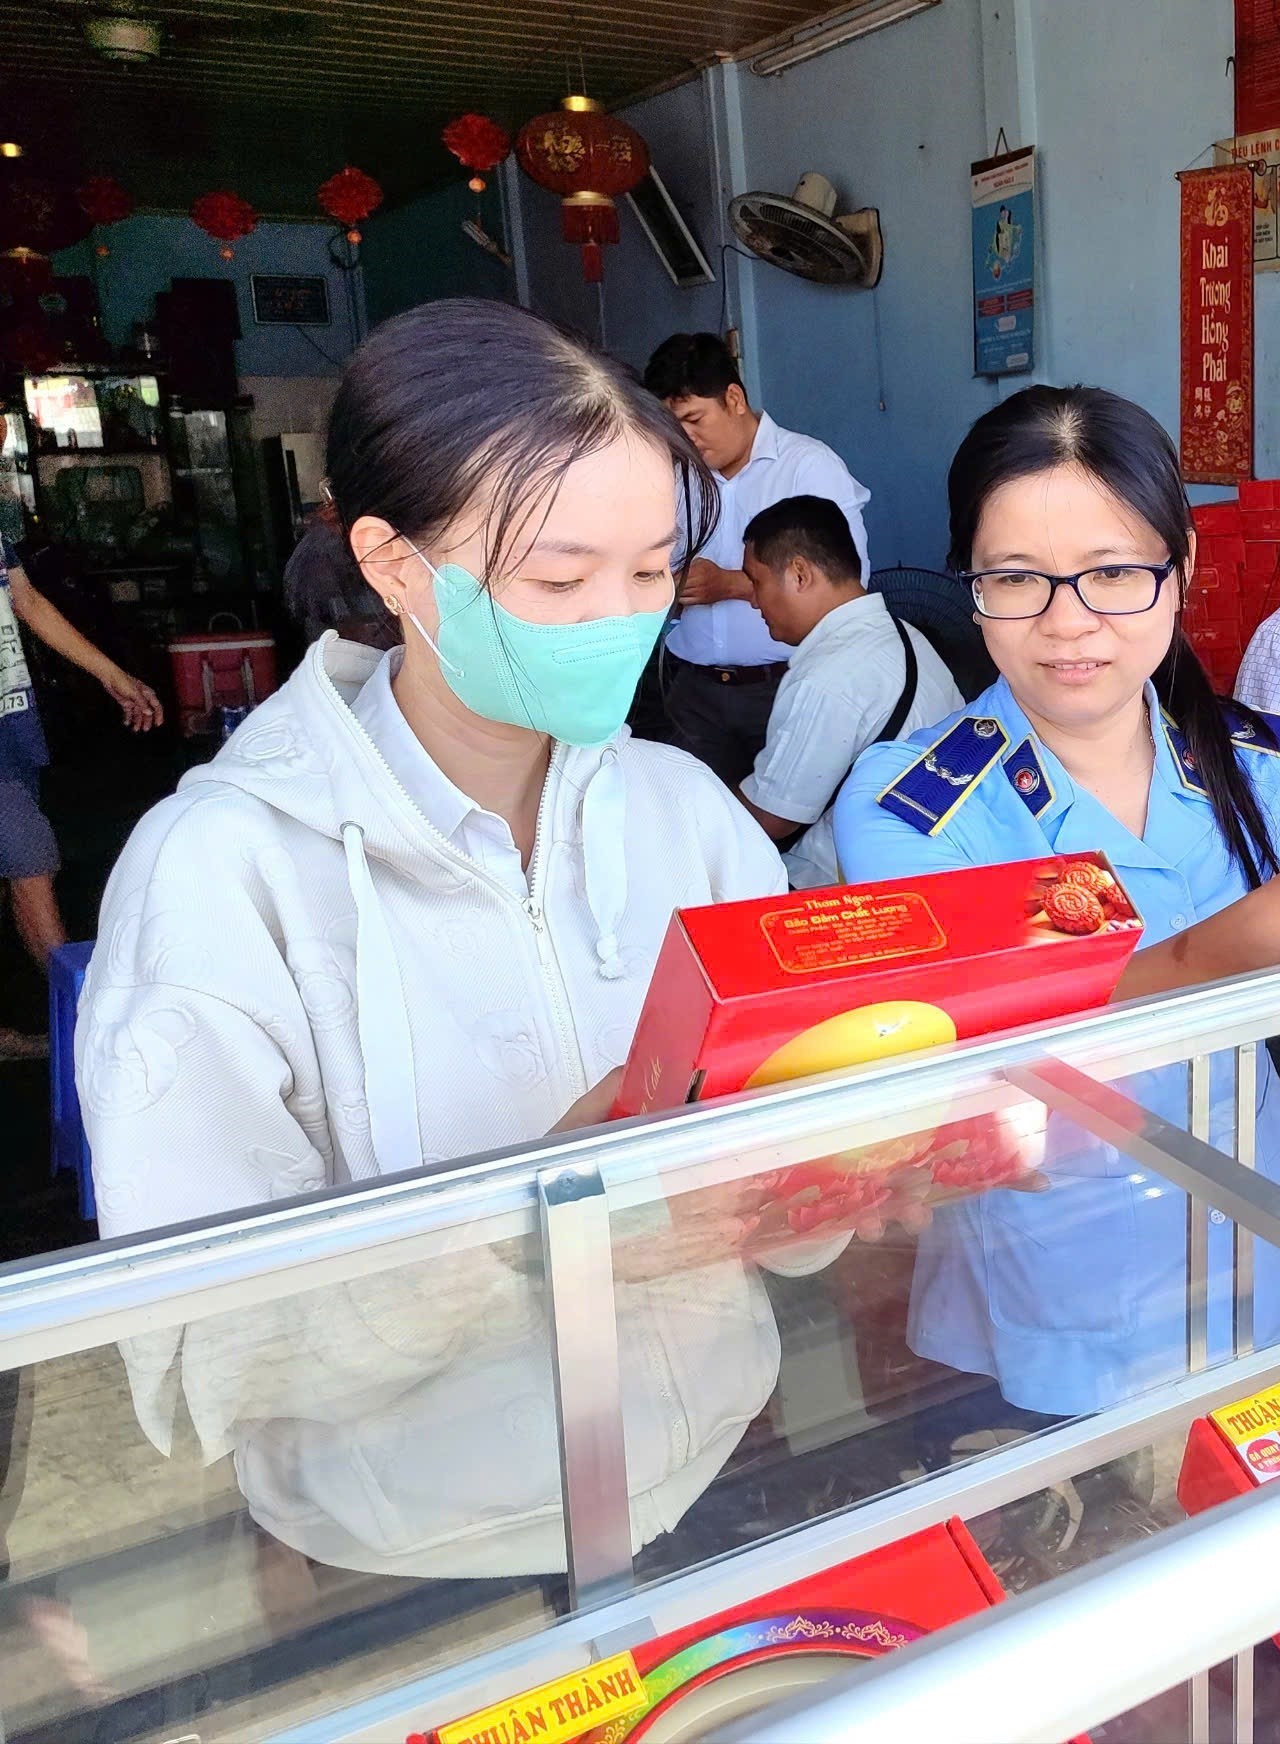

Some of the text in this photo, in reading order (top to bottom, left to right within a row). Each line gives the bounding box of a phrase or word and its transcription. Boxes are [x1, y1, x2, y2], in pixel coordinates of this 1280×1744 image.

[1202, 237, 1229, 270] Khai
[1201, 312, 1229, 352] Hồng
[1202, 350, 1227, 382] Phát
[841, 905, 871, 920] Chất
[843, 893, 875, 907] Ngon
[1260, 1443, 1280, 1458] QUAY
[549, 1668, 637, 1726] THÀNH
